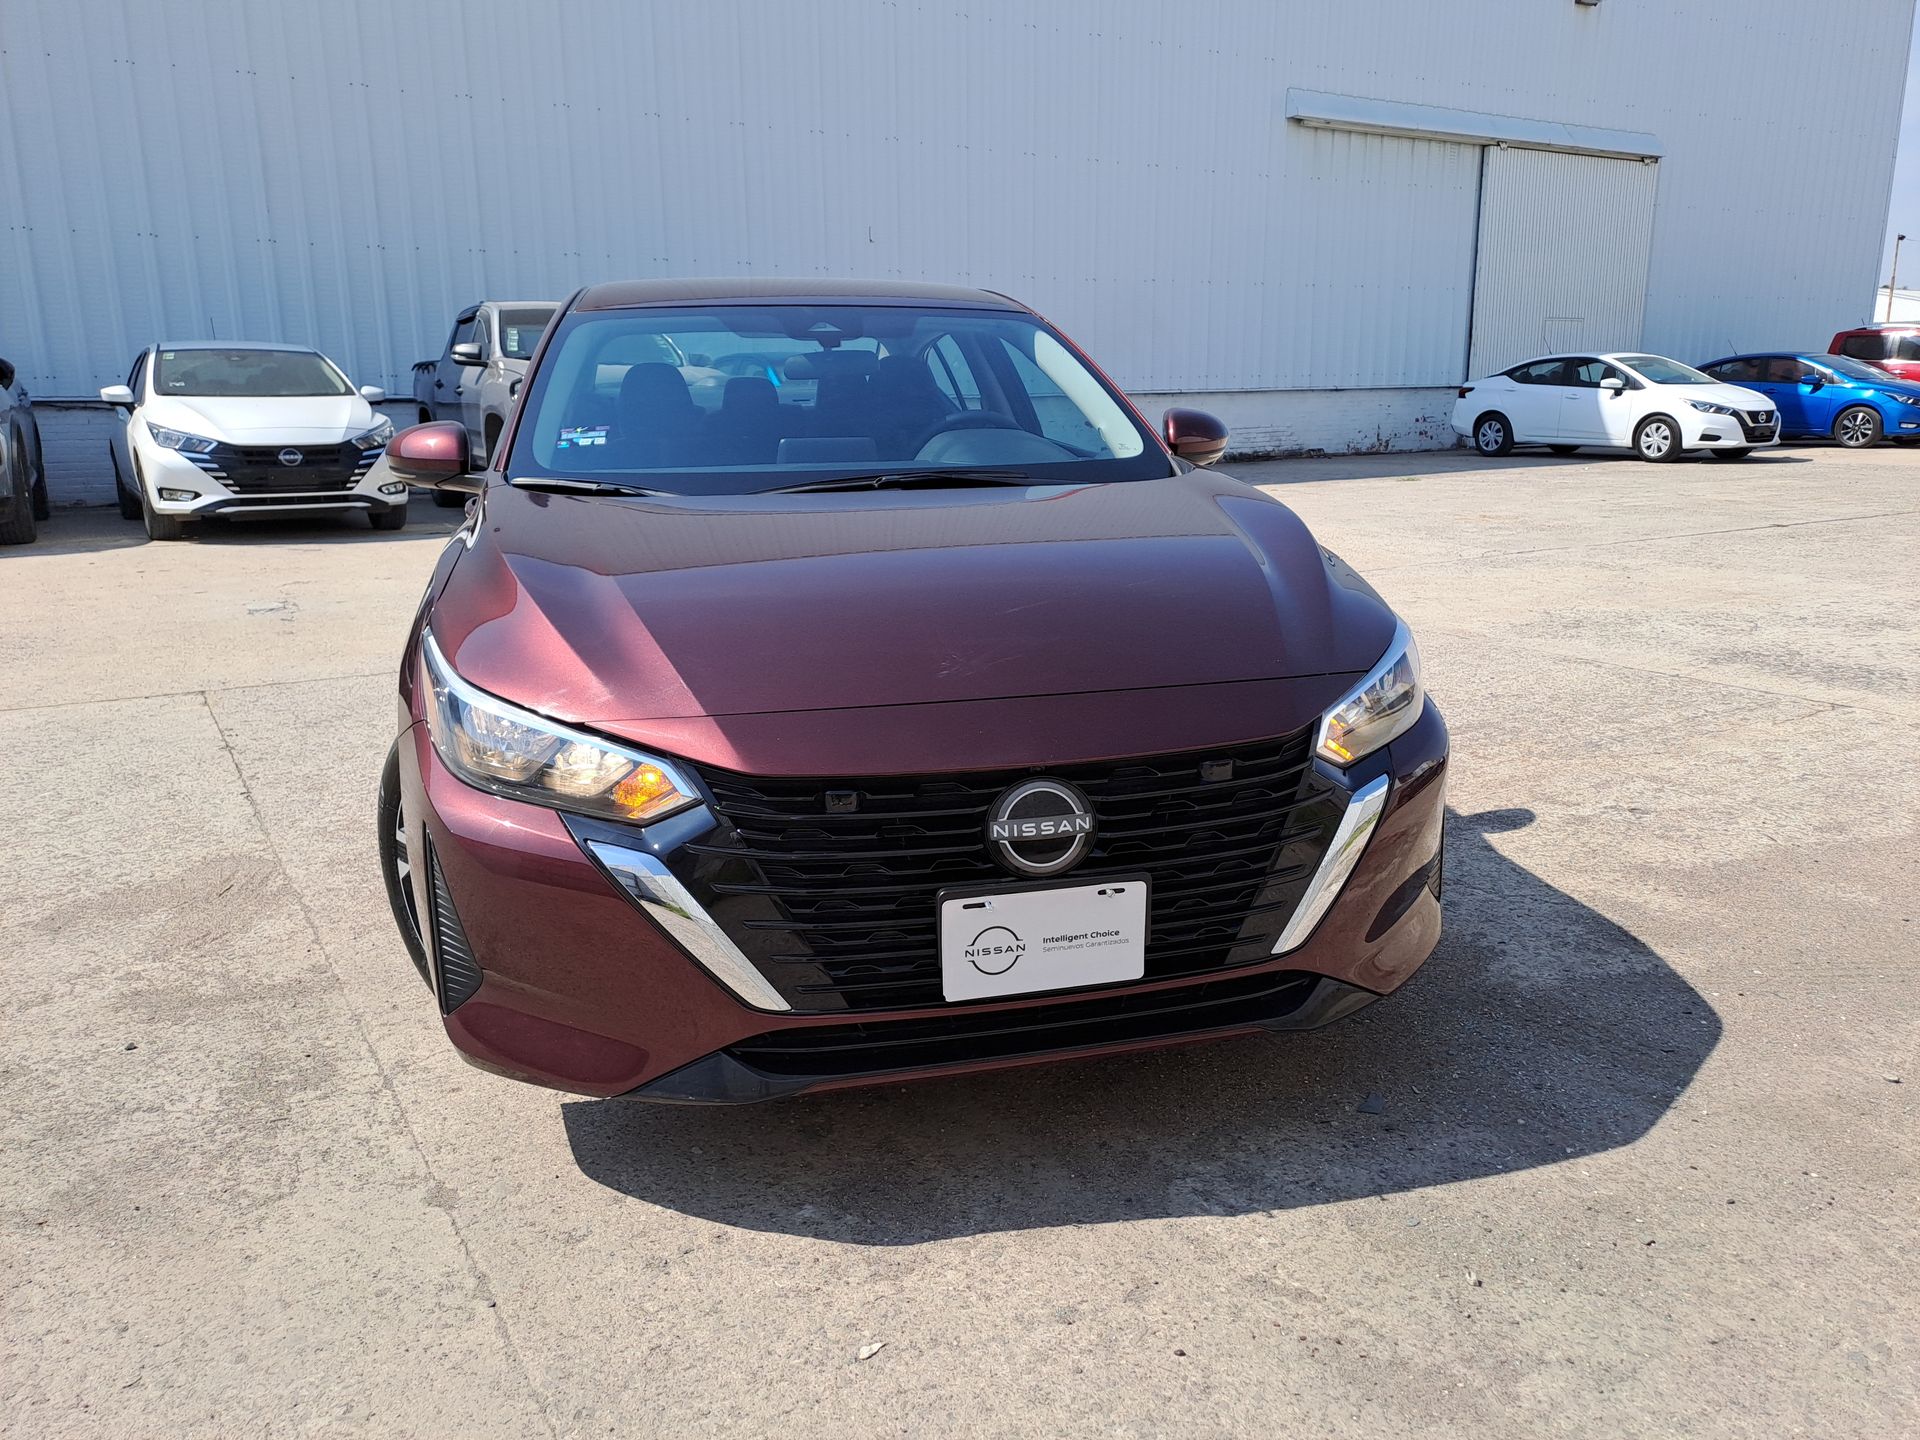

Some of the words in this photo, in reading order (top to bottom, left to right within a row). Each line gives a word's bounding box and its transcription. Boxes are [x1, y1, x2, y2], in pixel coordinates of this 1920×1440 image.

[993, 817, 1090, 838] NISSAN
[1042, 933, 1088, 944] Intelligent
[1090, 929, 1120, 939] Choice
[964, 943, 1026, 958] NISSAN
[1042, 943, 1084, 953] Seminuevos
[1085, 938, 1130, 948] Garantizados
